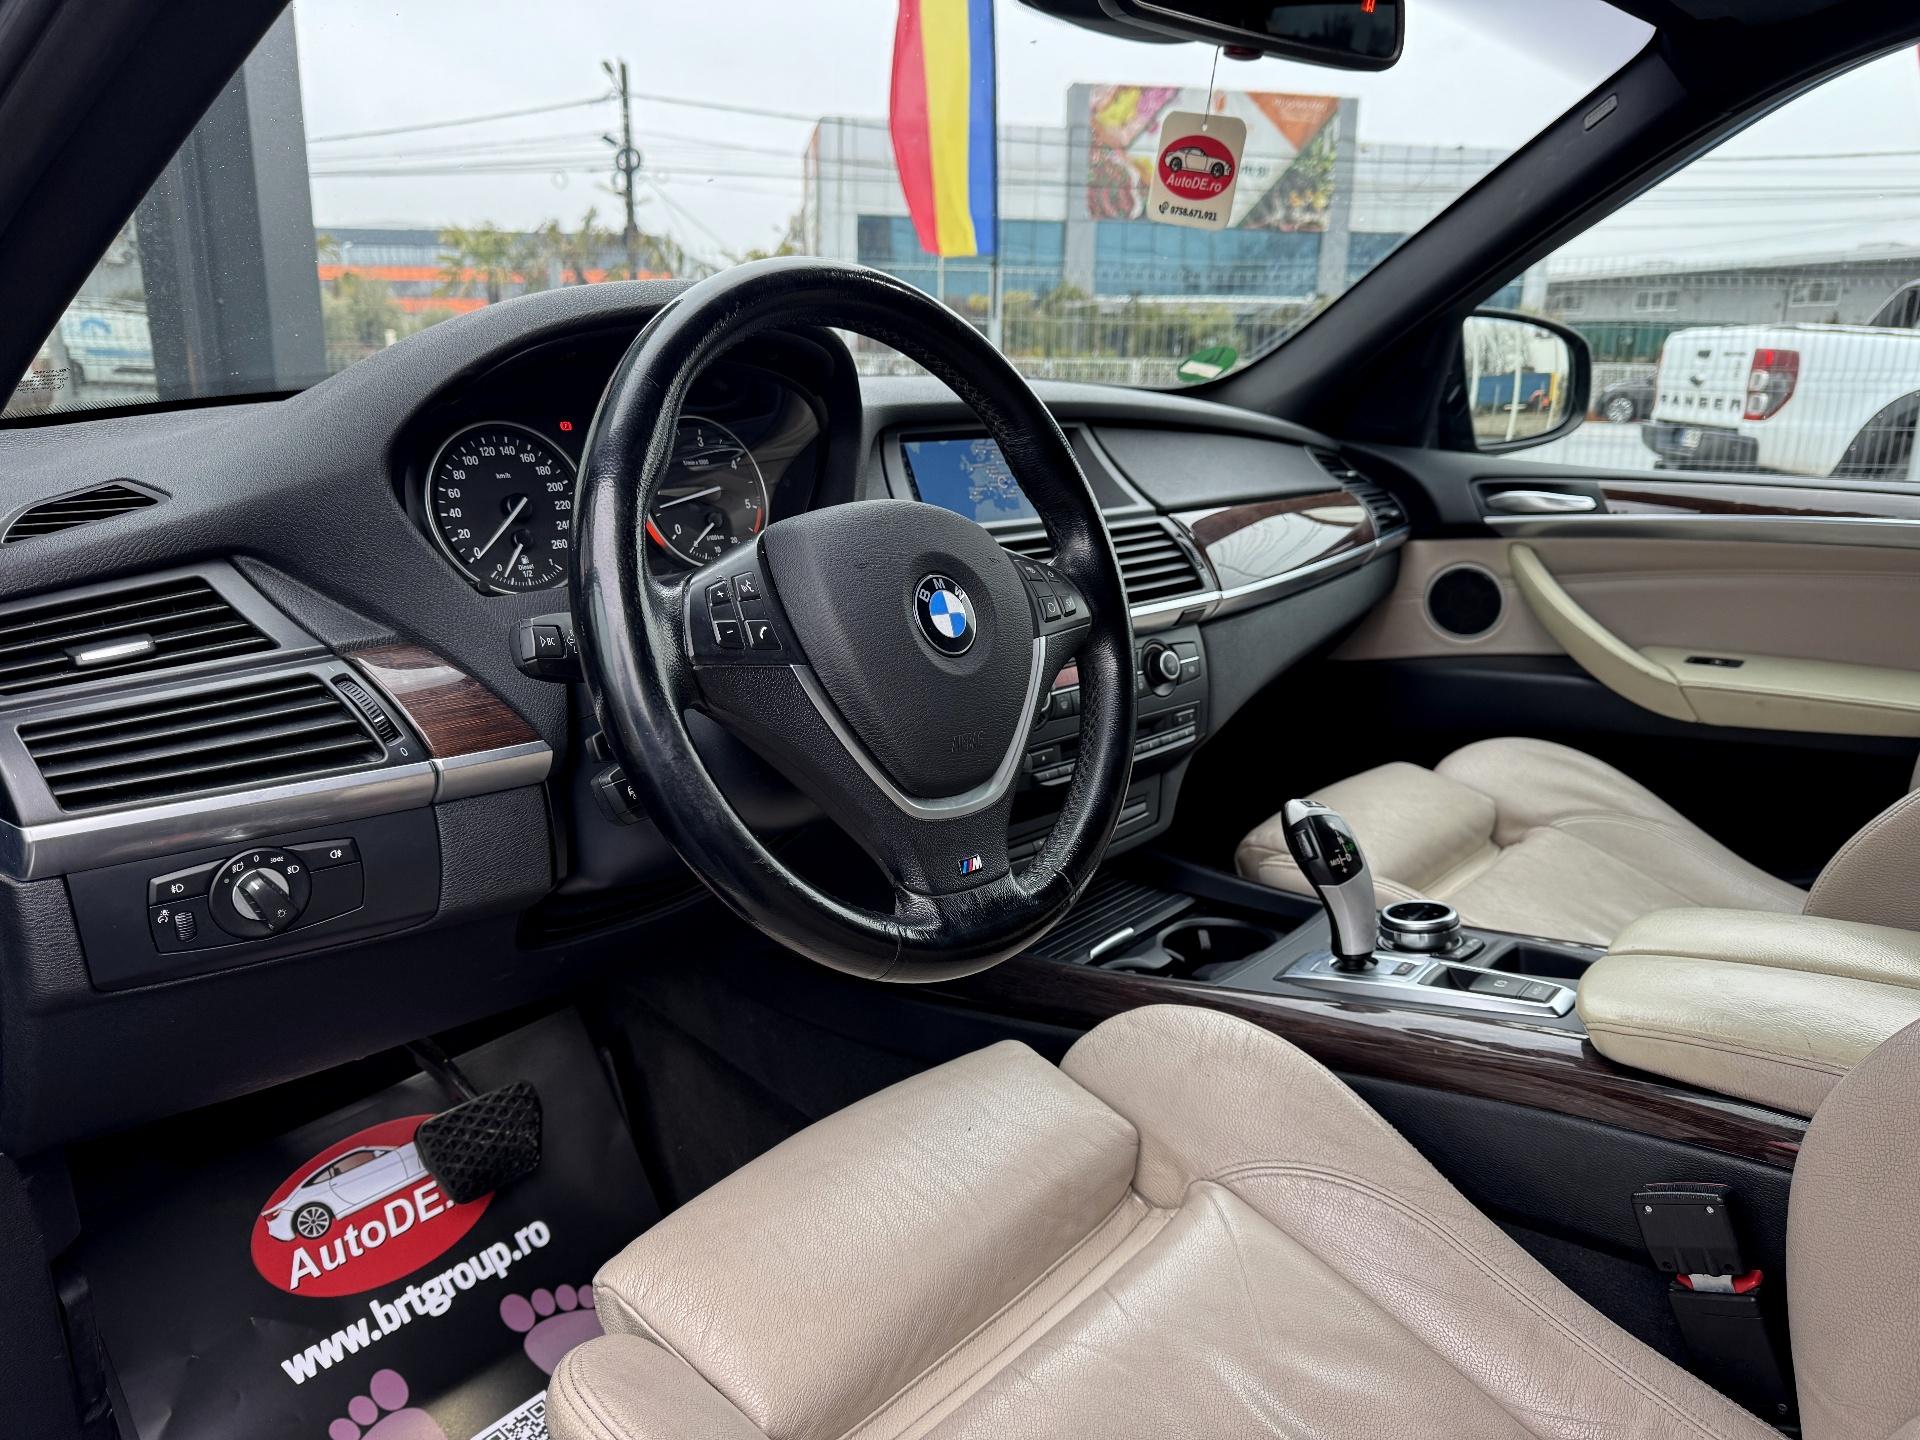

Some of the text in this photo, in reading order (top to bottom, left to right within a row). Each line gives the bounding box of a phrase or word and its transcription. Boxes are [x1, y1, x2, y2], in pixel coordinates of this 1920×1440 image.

[1166, 173, 1222, 192] AutoDE.ro
[697, 436, 704, 447] 3
[480, 446, 496, 457] 120
[500, 445, 516, 456] 140
[462, 455, 479, 466] 100
[520, 453, 536, 463] 160
[731, 460, 737, 470] 4
[452, 470, 466, 480] 80
[535, 466, 551, 476] 180
[546, 482, 563, 492] 200
[448, 488, 461, 498] 60
[555, 500, 571, 510] 220
[744, 499, 751, 509] 5
[449, 508, 462, 518] 40
[556, 520, 569, 530] 24
[674, 524, 682, 535] 0
[457, 528, 471, 539] 20
[551, 539, 568, 550] 260
[473, 547, 481, 557] 0
[497, 564, 503, 572] 0
[919, 578, 966, 602] BMW
[289, 1180, 456, 1290] AutoDE.
[281, 1220, 552, 1386] www.brtgroup.ro
